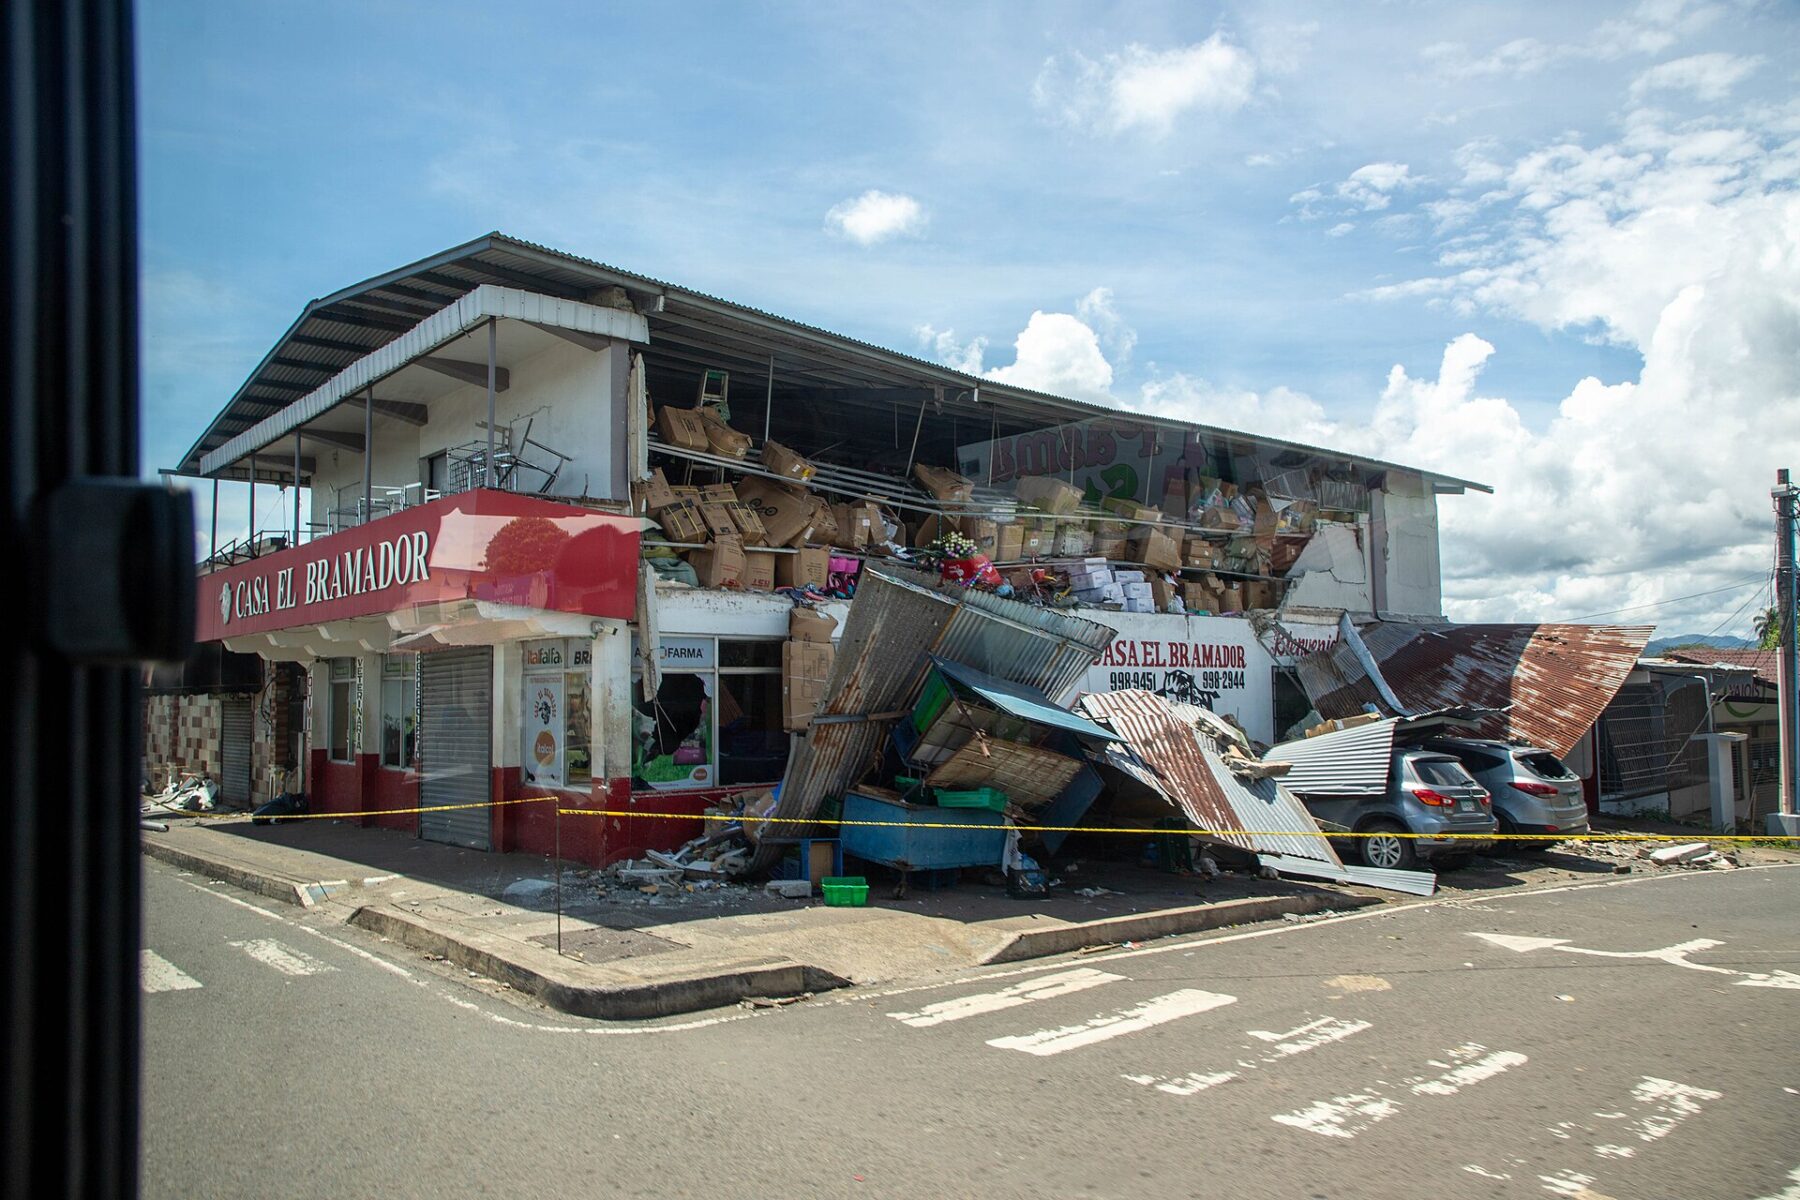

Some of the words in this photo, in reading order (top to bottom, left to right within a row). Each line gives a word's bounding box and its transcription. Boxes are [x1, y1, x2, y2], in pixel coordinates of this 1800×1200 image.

[235, 575, 270, 619] CASA
[276, 567, 297, 610] EL
[304, 530, 430, 605] BRAMADOR
[1092, 640, 1140, 668] ASA
[1141, 641, 1166, 667] EL
[1168, 642, 1247, 669] BRAMADOR
[1110, 671, 1156, 691] 998-9451
[1203, 670, 1245, 689] 998-2944
